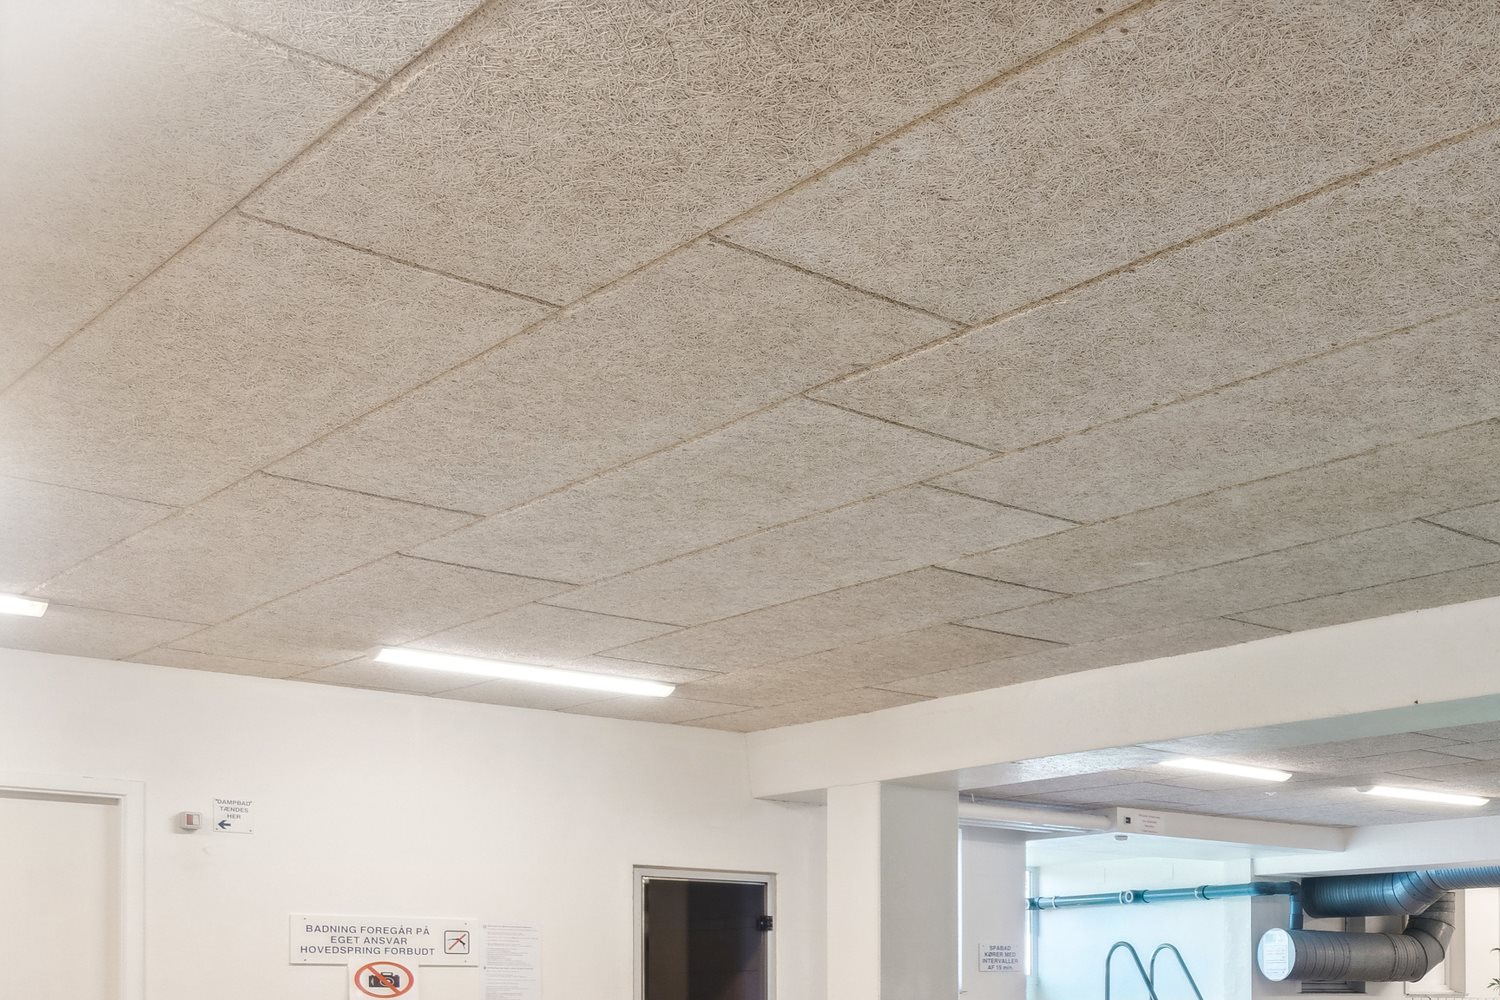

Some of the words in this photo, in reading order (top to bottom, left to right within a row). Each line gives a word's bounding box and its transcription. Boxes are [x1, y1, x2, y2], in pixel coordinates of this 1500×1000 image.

[305, 924, 357, 934] BADNING
[360, 924, 413, 936] FOREGÅR
[415, 925, 430, 936] PÅ
[330, 935, 360, 944] EGET
[363, 936, 408, 945] ANSVAR
[300, 945, 381, 955] HOVEDSPRING
[384, 946, 435, 956] FORBUDT
